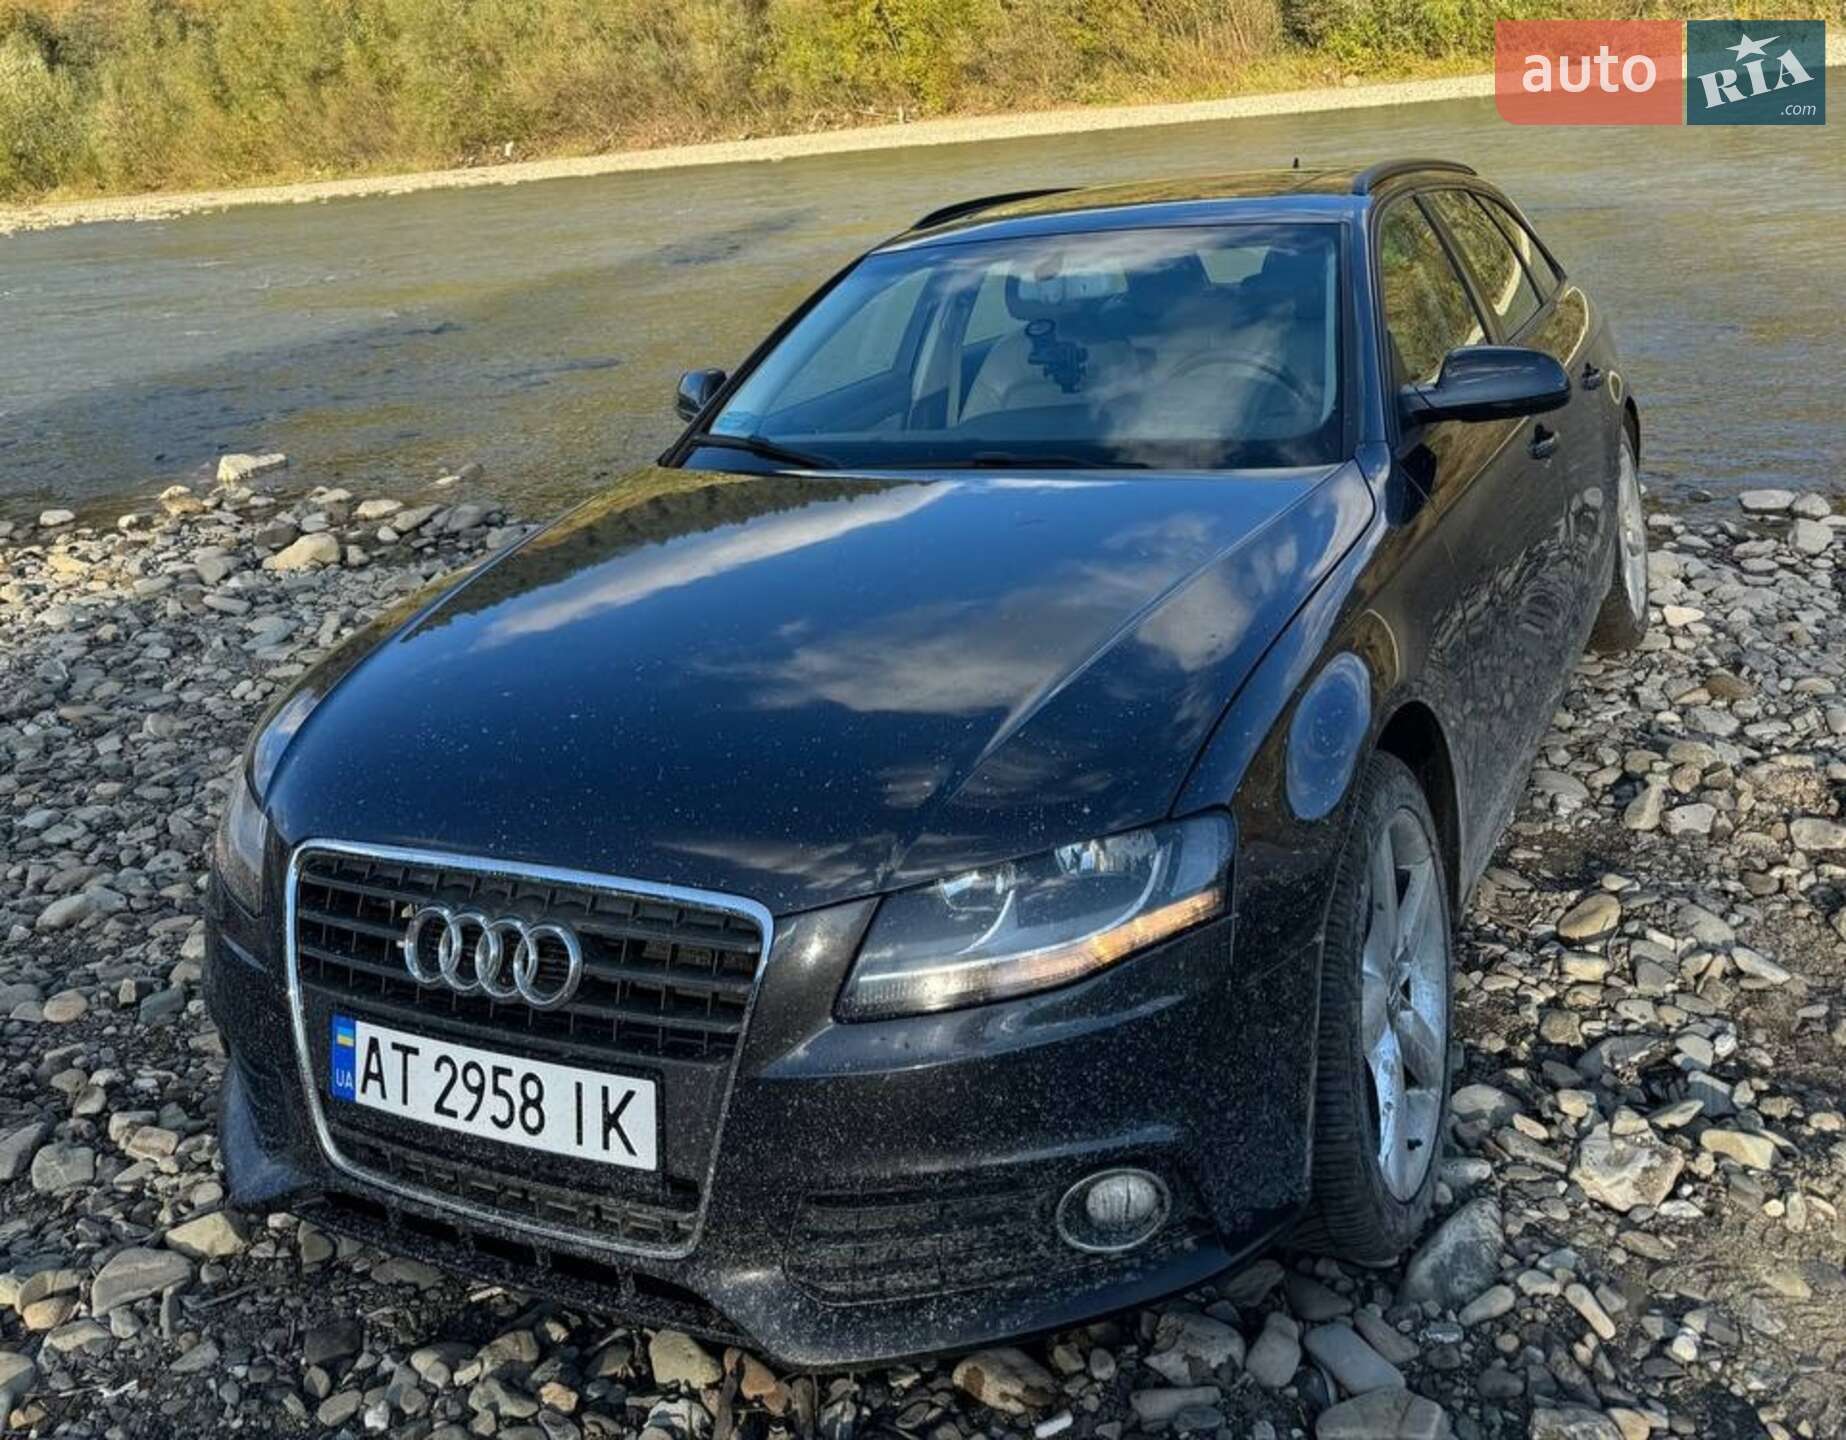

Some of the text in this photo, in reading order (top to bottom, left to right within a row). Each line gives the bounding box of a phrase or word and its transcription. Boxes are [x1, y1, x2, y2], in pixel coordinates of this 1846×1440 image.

[335, 1068, 354, 1090] UA
[360, 1035, 638, 1158] AT 2958 IK
